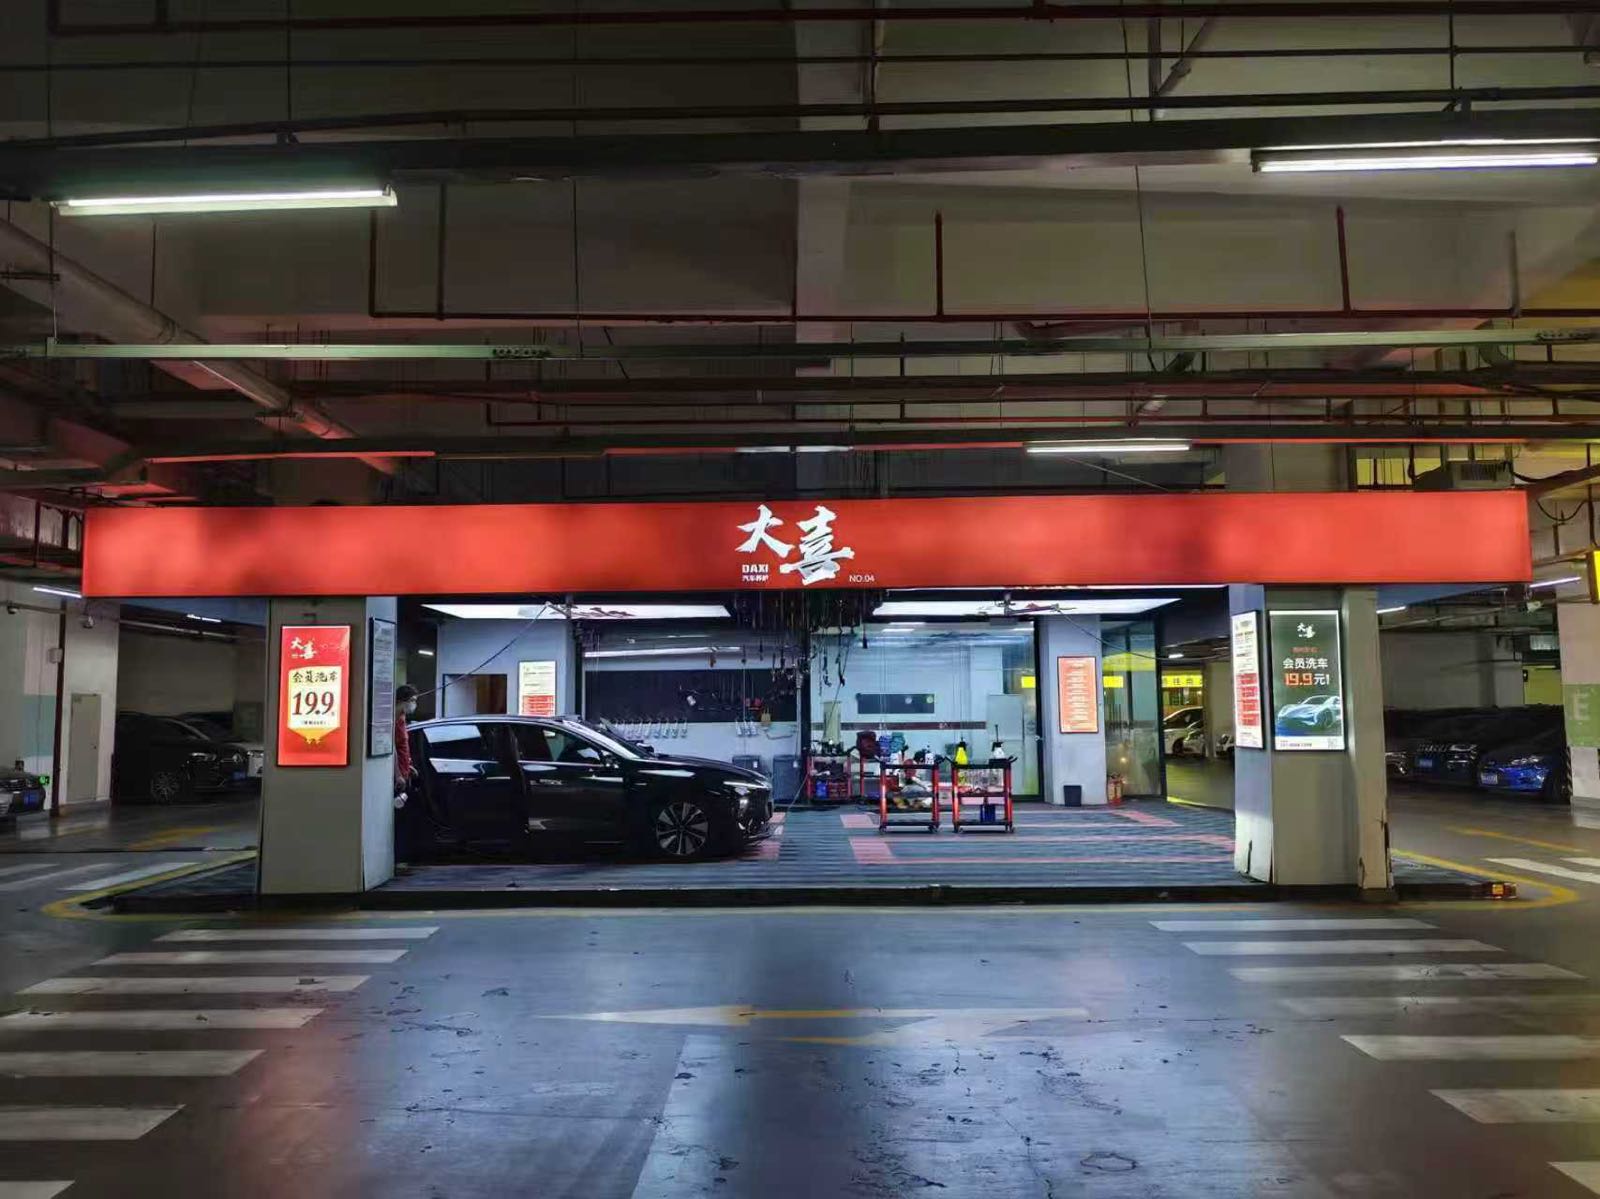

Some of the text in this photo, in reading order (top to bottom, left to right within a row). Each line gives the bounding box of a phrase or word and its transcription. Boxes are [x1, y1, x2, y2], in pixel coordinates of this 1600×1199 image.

[735, 504, 855, 586] 大喜
[742, 564, 769, 573] DAXI
[849, 574, 875, 583] NO.04
[1282, 657, 1328, 670] 会员洗车
[292, 691, 334, 715] 19.9
